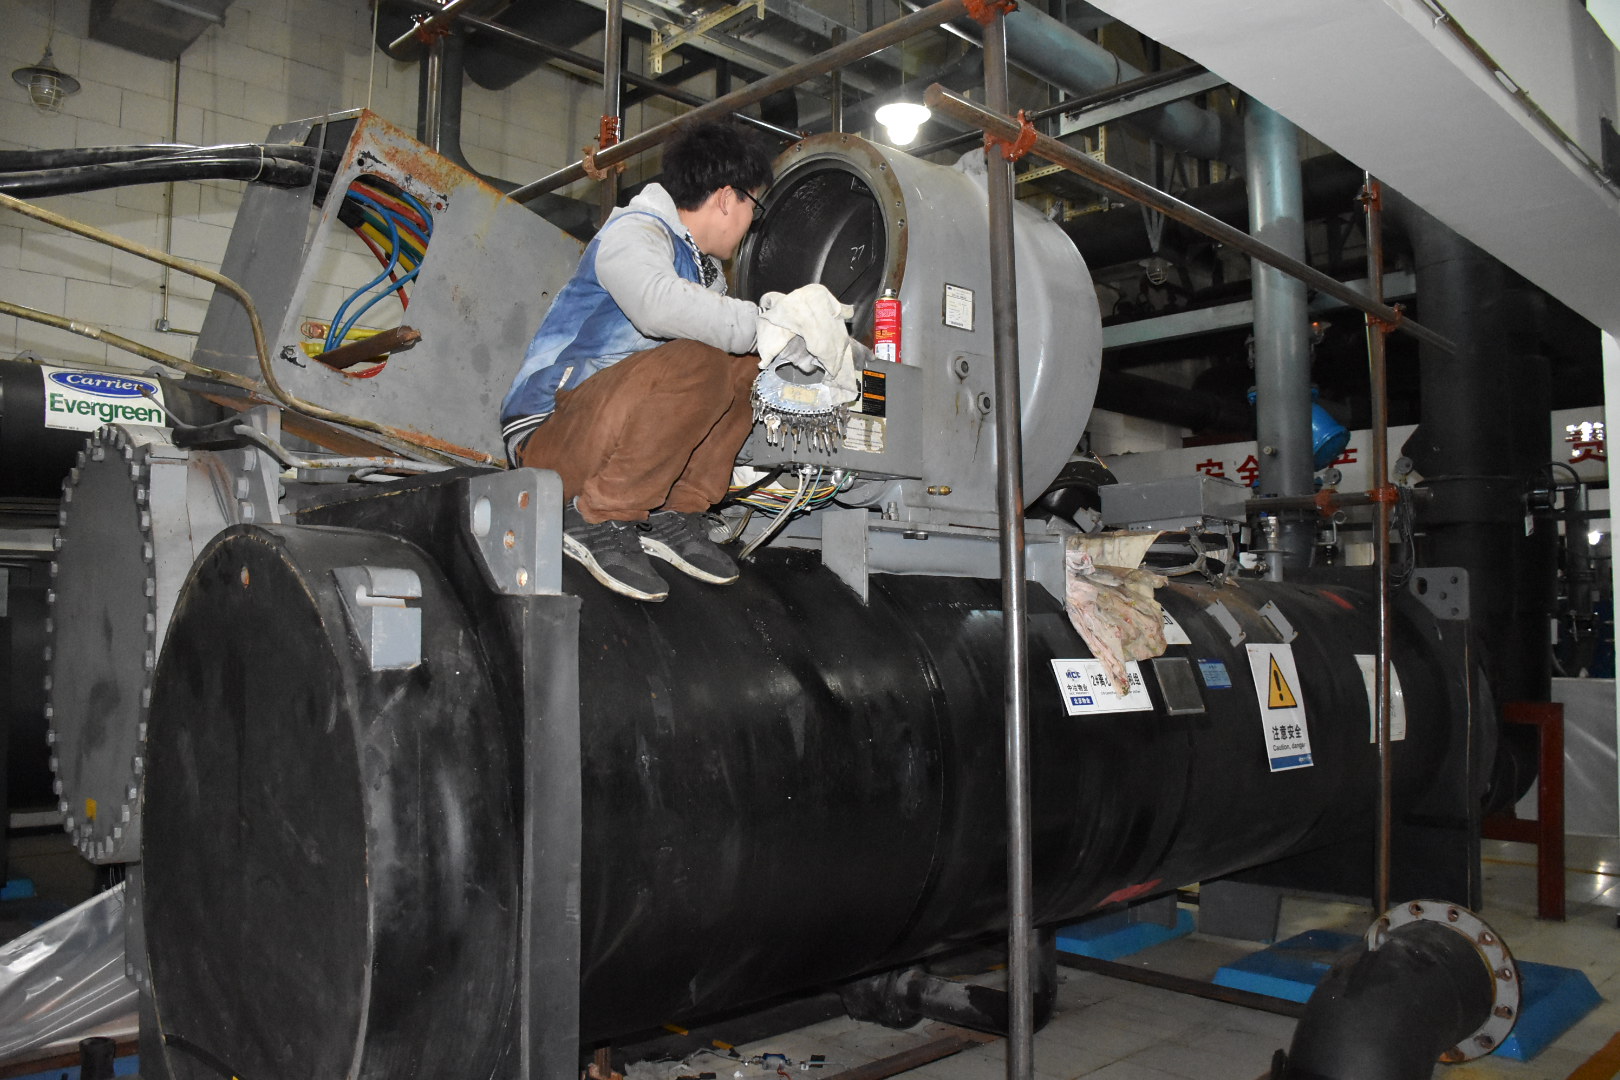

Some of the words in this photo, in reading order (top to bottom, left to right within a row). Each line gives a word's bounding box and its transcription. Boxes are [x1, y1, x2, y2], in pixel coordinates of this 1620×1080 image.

[66, 373, 144, 391] Carrier
[49, 392, 162, 423] Evergreen
[1272, 724, 1302, 741] 注意安全
